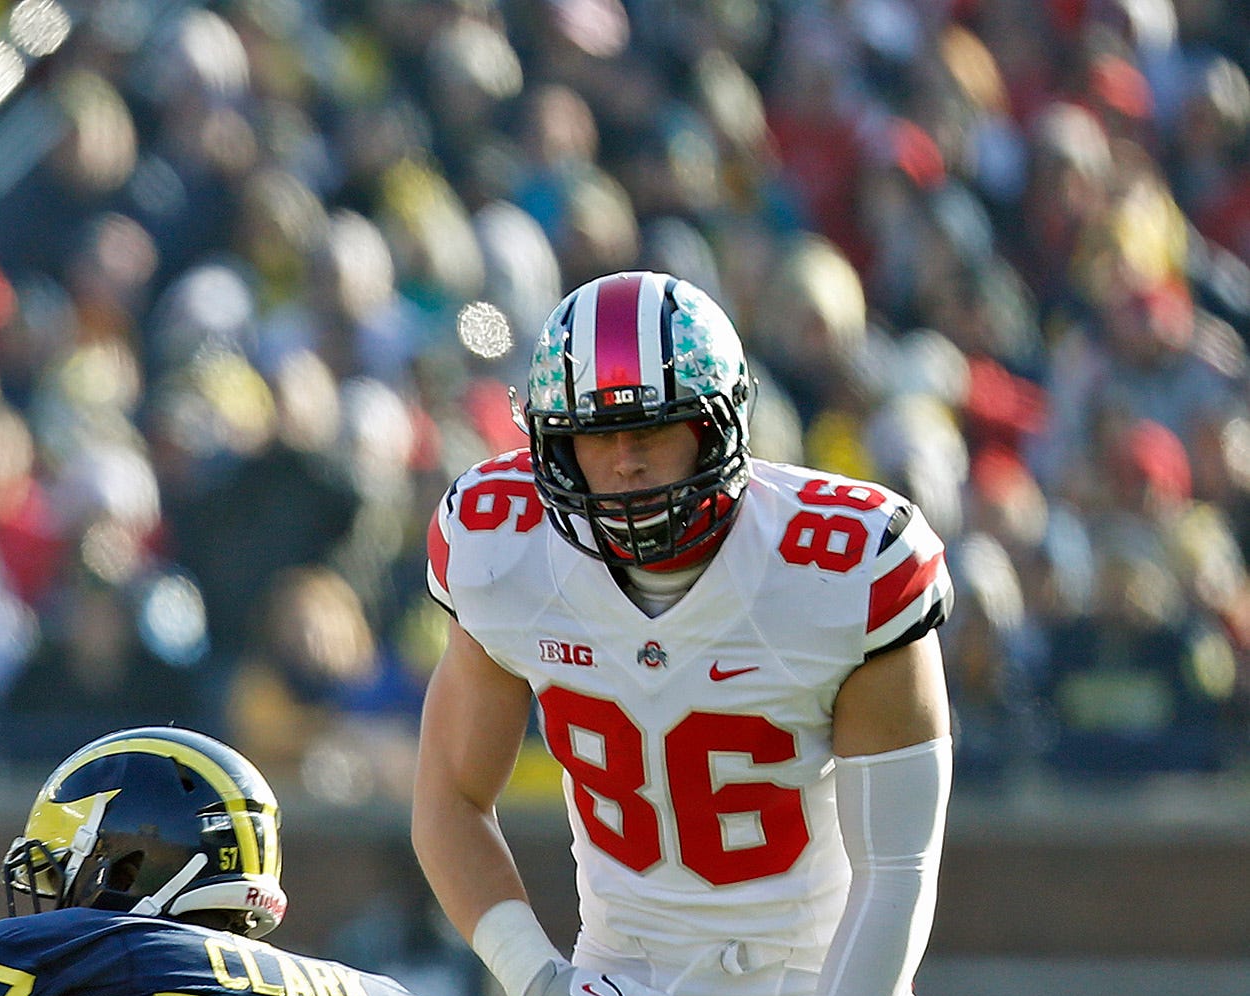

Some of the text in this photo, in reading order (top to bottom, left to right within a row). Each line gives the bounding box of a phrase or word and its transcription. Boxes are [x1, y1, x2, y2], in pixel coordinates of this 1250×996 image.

[777, 479, 887, 574] 86
[537, 684, 812, 887] 86
[219, 847, 239, 871] 57
